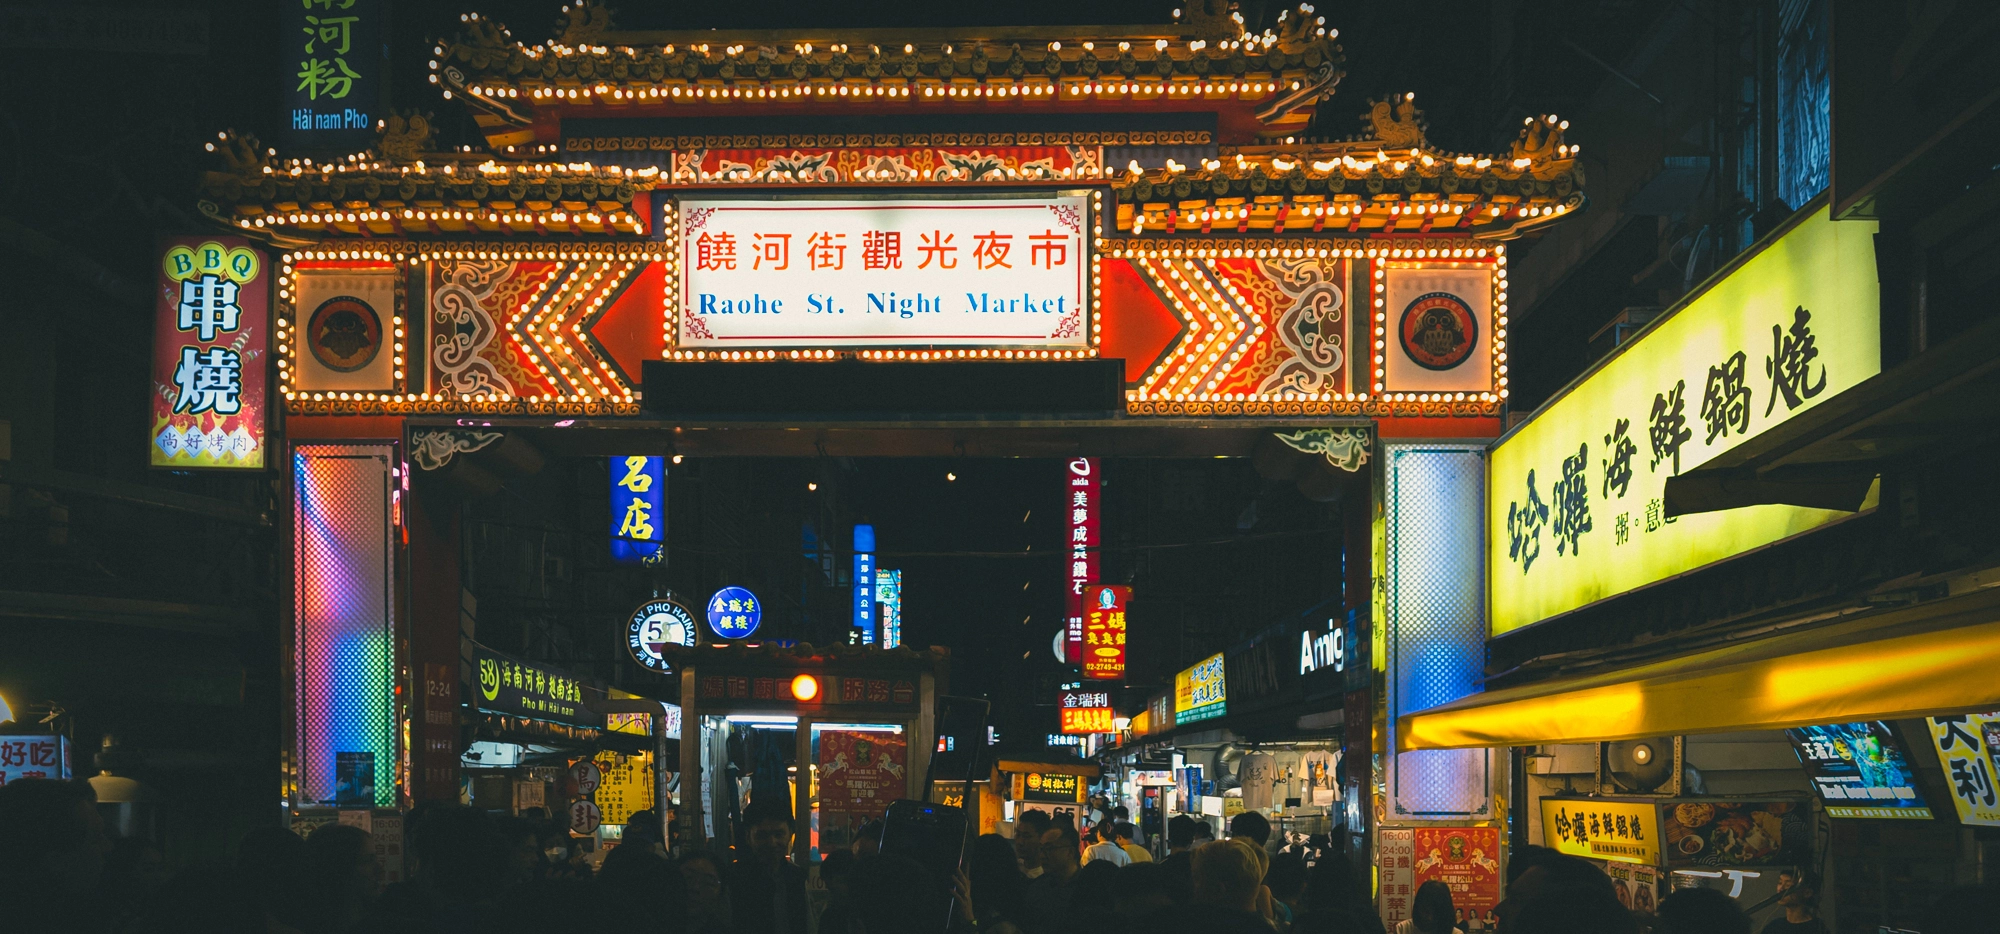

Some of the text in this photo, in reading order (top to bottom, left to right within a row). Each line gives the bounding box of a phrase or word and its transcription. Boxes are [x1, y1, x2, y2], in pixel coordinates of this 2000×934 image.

[297, 0, 361, 100] 河粉
[315, 113, 341, 129] nam
[344, 108, 369, 129] Pho
[172, 248, 251, 277] BBQ
[696, 229, 1070, 271] 饒河街觀光夜市
[698, 292, 1066, 319] Raohe St. Night Market
[174, 275, 241, 414] 串燒
[162, 434, 248, 452] 尚好烤肉
[1507, 305, 1827, 575] 哈囉海鮮鍋燒
[1072, 478, 1089, 486] aida
[618, 455, 654, 540] 名店
[1073, 491, 1087, 595] 美夢成真鑽石
[630, 611, 646, 632] CAY
[646, 602, 671, 614] PHO
[672, 606, 696, 647] HAINAM
[1088, 612, 1126, 630] 三媽
[480, 658, 495, 687] 58
[843, 677, 914, 703] 服務台
[1063, 693, 1108, 708] 金瑞利
[522, 696, 536, 710] Pho
[538, 699, 547, 711] Mi
[561, 706, 574, 716] nam
[1064, 709, 1112, 730] 三媽臭臭鍋
[1, 741, 56, 767] 好吃
[1042, 778, 1075, 790] 胡椒餅
[1383, 832, 1410, 840] 16:00
[1555, 807, 1644, 847] 哈囉海鮮鍋燒
[1383, 846, 1410, 855] 24:00
